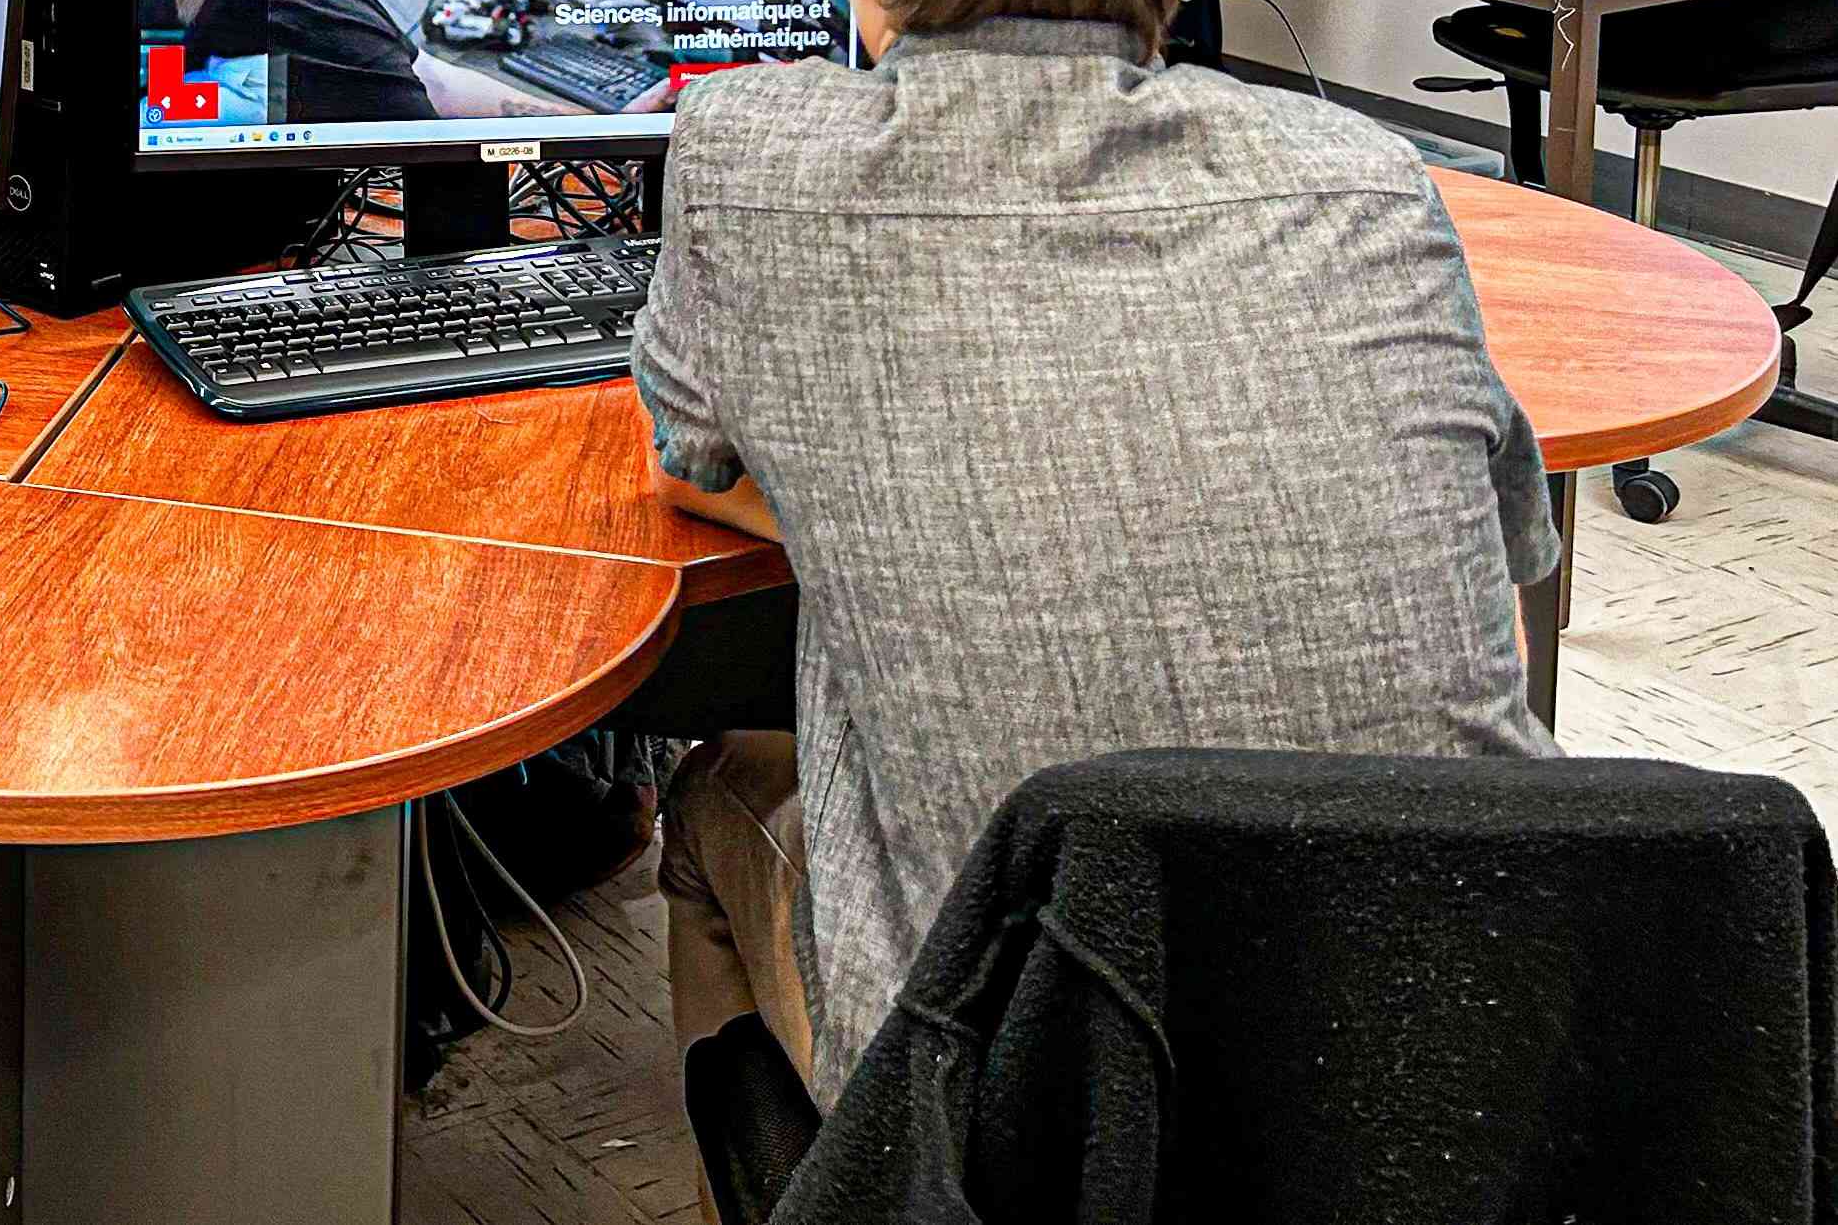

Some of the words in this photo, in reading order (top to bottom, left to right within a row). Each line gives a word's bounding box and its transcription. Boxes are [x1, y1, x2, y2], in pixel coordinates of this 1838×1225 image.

[554, 4, 663, 26] Sciences,
[667, 1, 804, 24] informatique
[808, 0, 831, 19] et
[673, 28, 830, 51] mathématique
[9, 186, 29, 200] DELL
